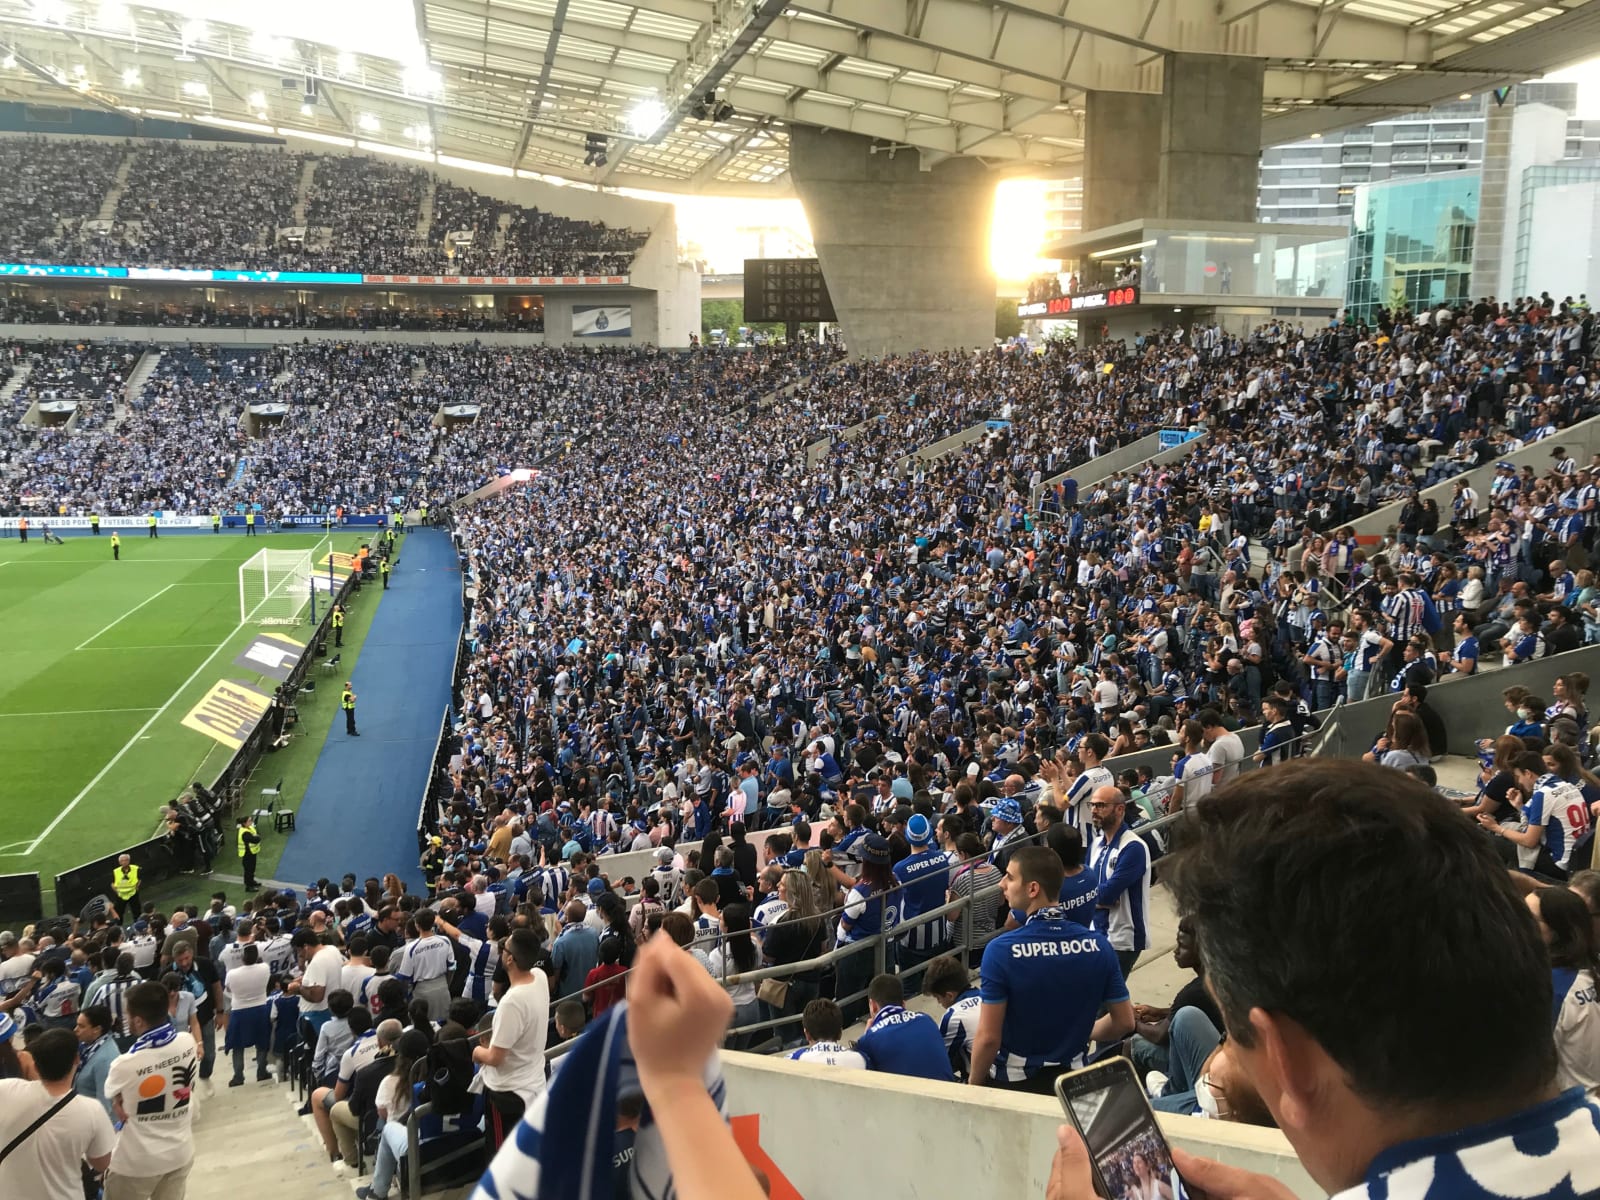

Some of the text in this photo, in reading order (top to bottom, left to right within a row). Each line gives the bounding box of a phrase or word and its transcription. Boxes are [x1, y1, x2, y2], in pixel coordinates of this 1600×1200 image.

[906, 854, 947, 873] SUPER BOC
[663, 881, 673, 901] 3
[1085, 886, 1099, 902] BOC
[768, 903, 788, 915] SUPER
[695, 927, 718, 938] SUPER
[1011, 938, 1101, 958] SUPER BOCK
[960, 997, 980, 1010] SUP
[870, 1014, 902, 1033] SUPER
[136, 1065, 154, 1077] WE
[154, 1055, 181, 1071] NEED
[150, 1112, 171, 1122] OUR
